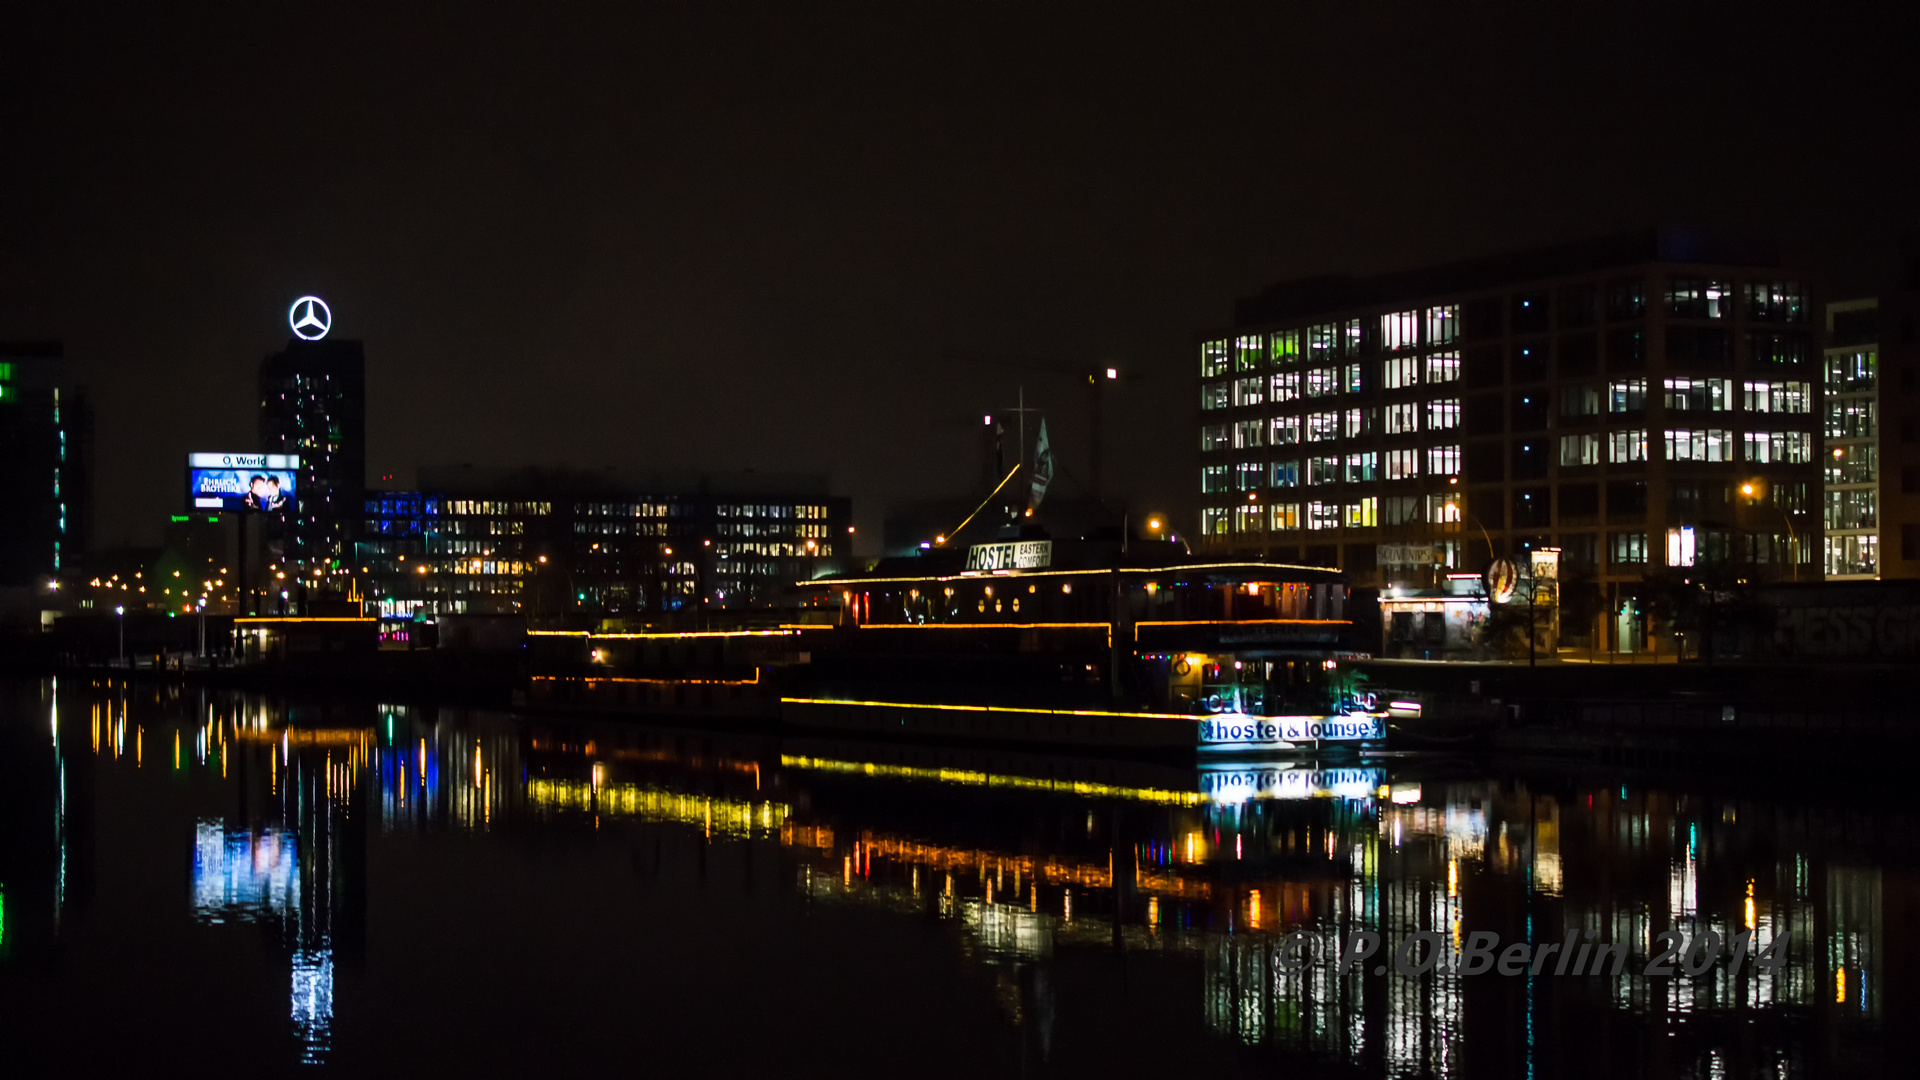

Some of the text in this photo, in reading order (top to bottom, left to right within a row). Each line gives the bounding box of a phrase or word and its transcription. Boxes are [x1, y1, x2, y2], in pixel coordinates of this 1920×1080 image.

[236, 455, 267, 466] World
[1019, 542, 1049, 554] EASTERN
[968, 544, 1017, 570] HOSTEL
[1216, 720, 1370, 740] hostel & lounge
